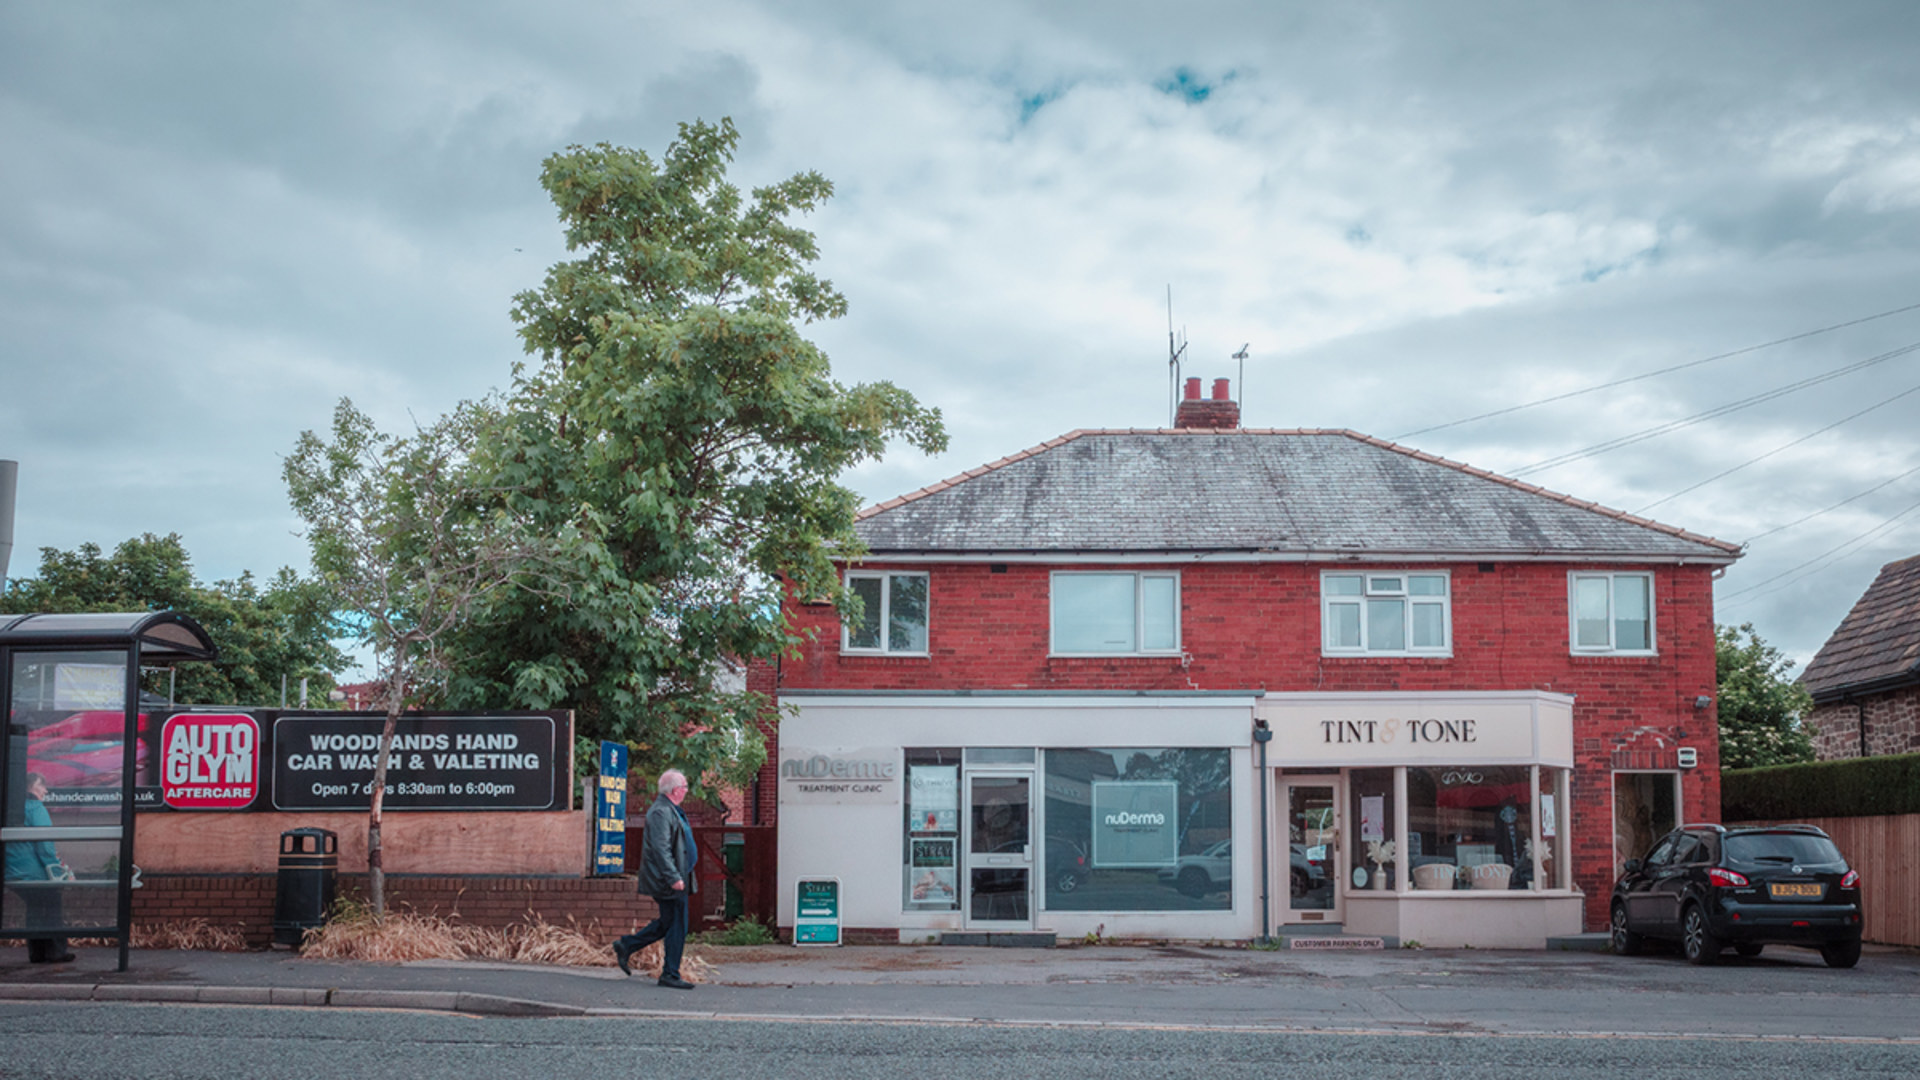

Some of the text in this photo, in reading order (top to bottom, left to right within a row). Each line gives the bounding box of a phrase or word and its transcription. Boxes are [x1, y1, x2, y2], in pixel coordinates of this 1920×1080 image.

[168, 723, 253, 756] AUTO
[1321, 720, 1377, 743] TINT
[1406, 719, 1477, 743] TONE
[456, 734, 518, 750] HAND
[167, 753, 252, 785] GLYM
[288, 754, 332, 771] CAR
[408, 754, 425, 770] &
[432, 753, 540, 770] VALETING
[782, 755, 897, 778] nuDerma
[166, 787, 252, 798] AFTERCARE
[311, 780, 515, 798] Open 7 ds 8:30am to 6:00pm
[798, 784, 883, 793] TREATMENT CLINIC
[1105, 811, 1165, 825] nuDerma
